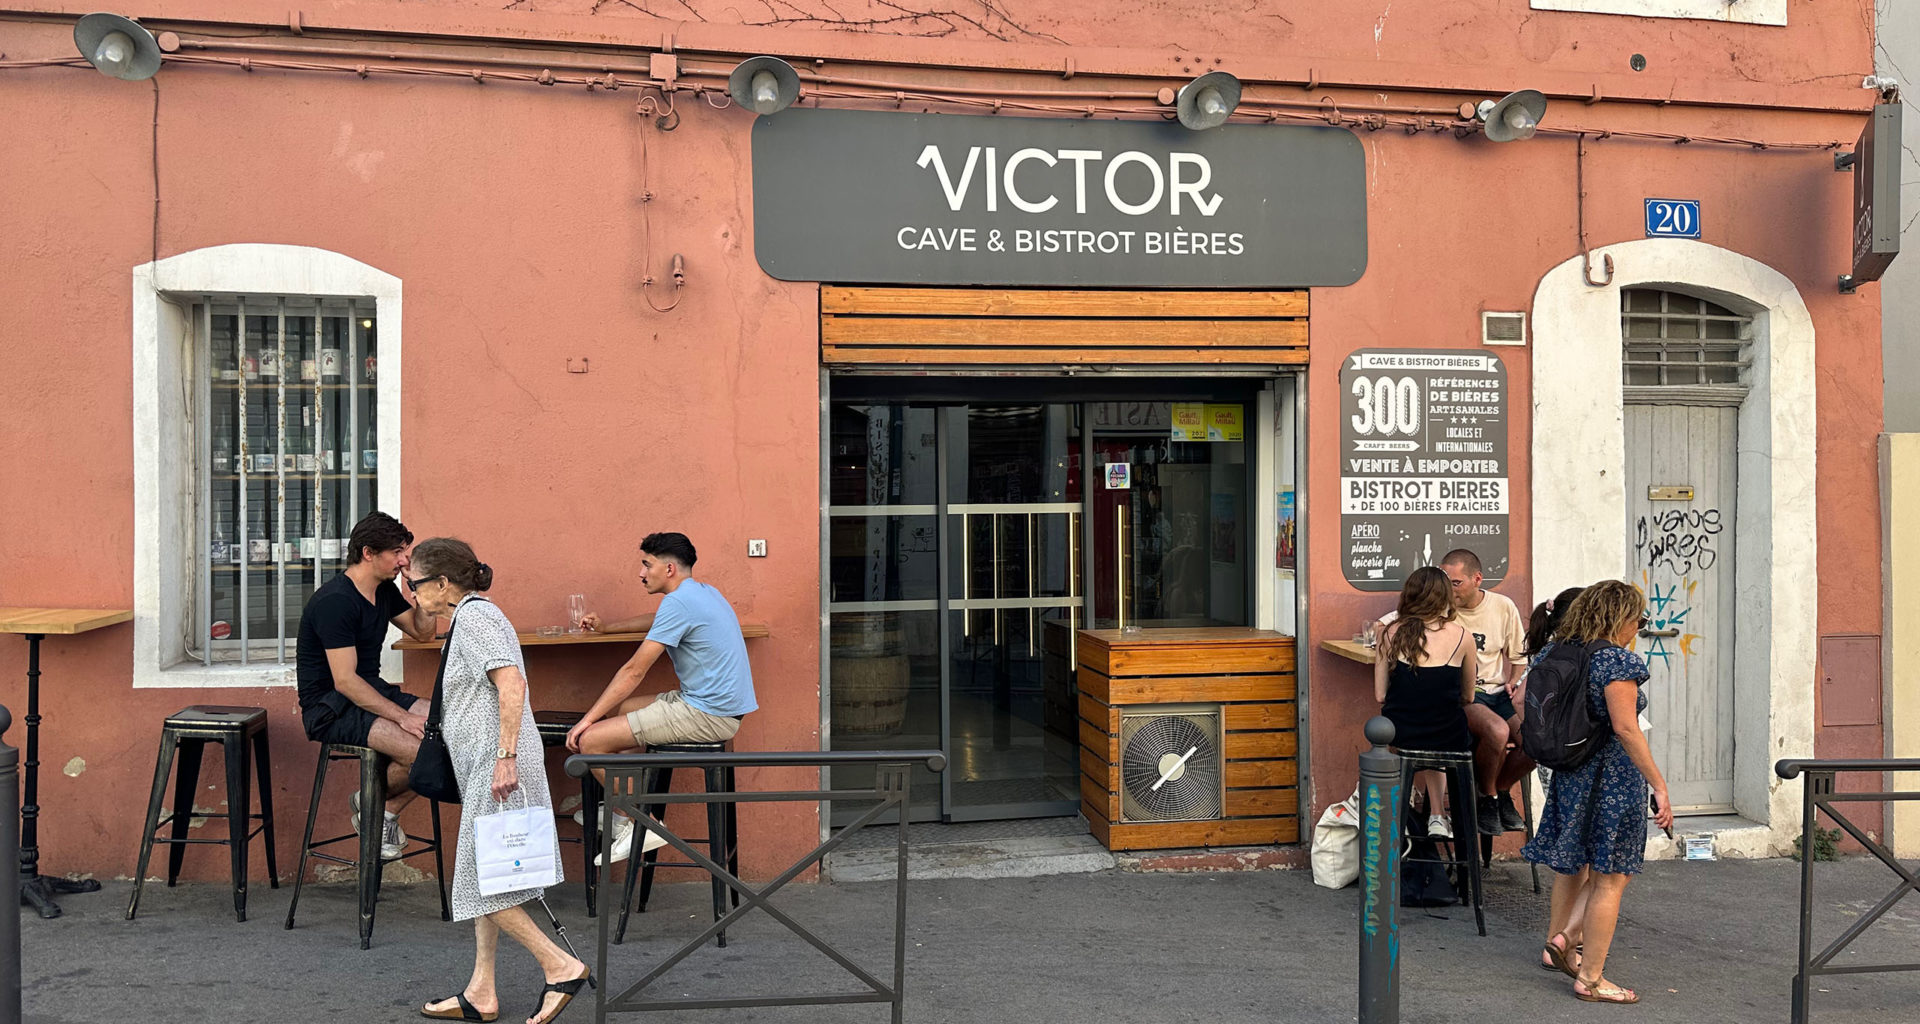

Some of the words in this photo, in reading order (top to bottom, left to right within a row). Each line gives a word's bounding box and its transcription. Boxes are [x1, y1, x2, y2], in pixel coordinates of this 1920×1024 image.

[916, 145, 1224, 216] VICTOR
[1655, 203, 1691, 233] 20
[897, 226, 977, 251] CAVE
[986, 228, 1006, 252] &
[1015, 229, 1136, 254] BISTROT
[1144, 225, 1244, 255] BIÈRES
[1369, 357, 1396, 366] CAVE
[1397, 357, 1405, 366] &
[1406, 357, 1446, 367] BISTROT
[1447, 356, 1481, 367] BIÈRES
[1429, 377, 1500, 389] RÉFÉRENCES
[1430, 390, 1450, 402] DE
[1451, 389, 1500, 403] BIÈRES
[1351, 375, 1420, 436] 300
[1429, 405, 1500, 415] ARTISANALES
[1446, 427, 1474, 439] LOCALES
[1474, 427, 1483, 439] ET
[1435, 441, 1494, 453] INTERNATIONALES
[1350, 458, 1400, 473] VENTE
[1402, 455, 1415, 473] À
[1418, 458, 1499, 473] EMPORTER
[1350, 480, 1433, 499] BISTROT
[1439, 481, 1500, 499] BIERES
[1350, 503, 1357, 511] +
[1361, 501, 1375, 511] DE
[1380, 501, 1400, 511] 100
[1404, 498, 1442, 511] BIÈRES
[1446, 498, 1500, 511] FRAÎCHES
[1351, 521, 1380, 537] APÉRO
[1444, 524, 1501, 535] HORAIRES
[1350, 541, 1383, 555] plancha
[1351, 556, 1383, 569] épicerie
[1384, 555, 1401, 570] fine
